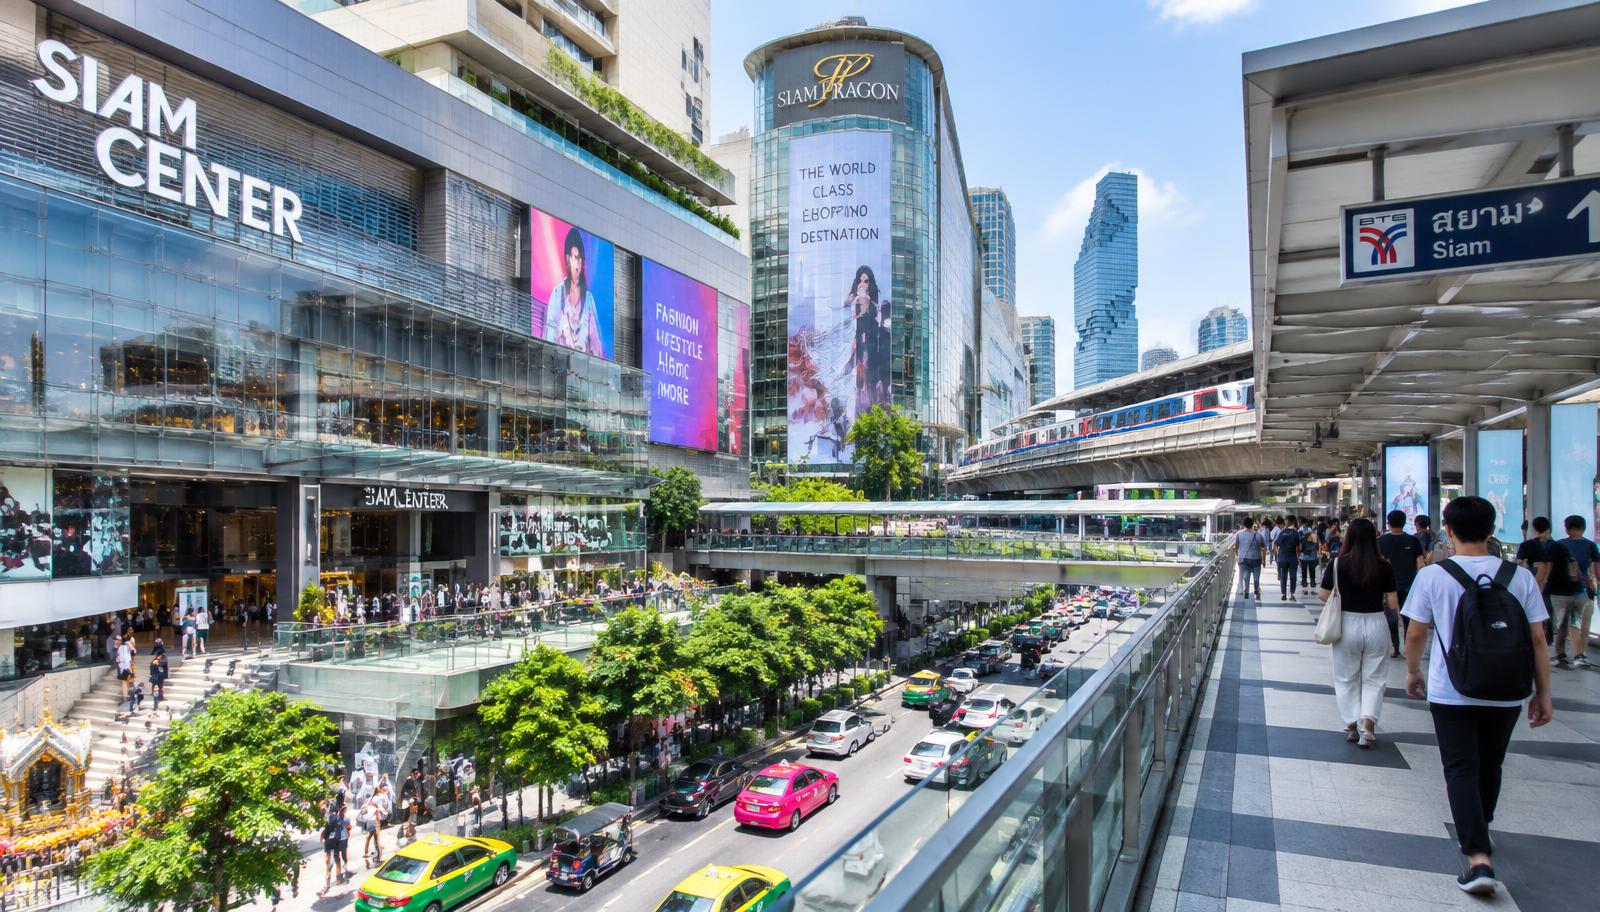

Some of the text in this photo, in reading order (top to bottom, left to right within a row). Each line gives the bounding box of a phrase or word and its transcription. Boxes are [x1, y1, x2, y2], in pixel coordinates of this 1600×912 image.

[32, 38, 197, 152] SIAM
[777, 84, 818, 108] SIAM
[799, 162, 876, 181] THE WORLD
[95, 126, 303, 244] CENTER
[812, 183, 854, 199] CLASS
[800, 227, 879, 244] DESTNATION
[1432, 238, 1491, 260] Siam
